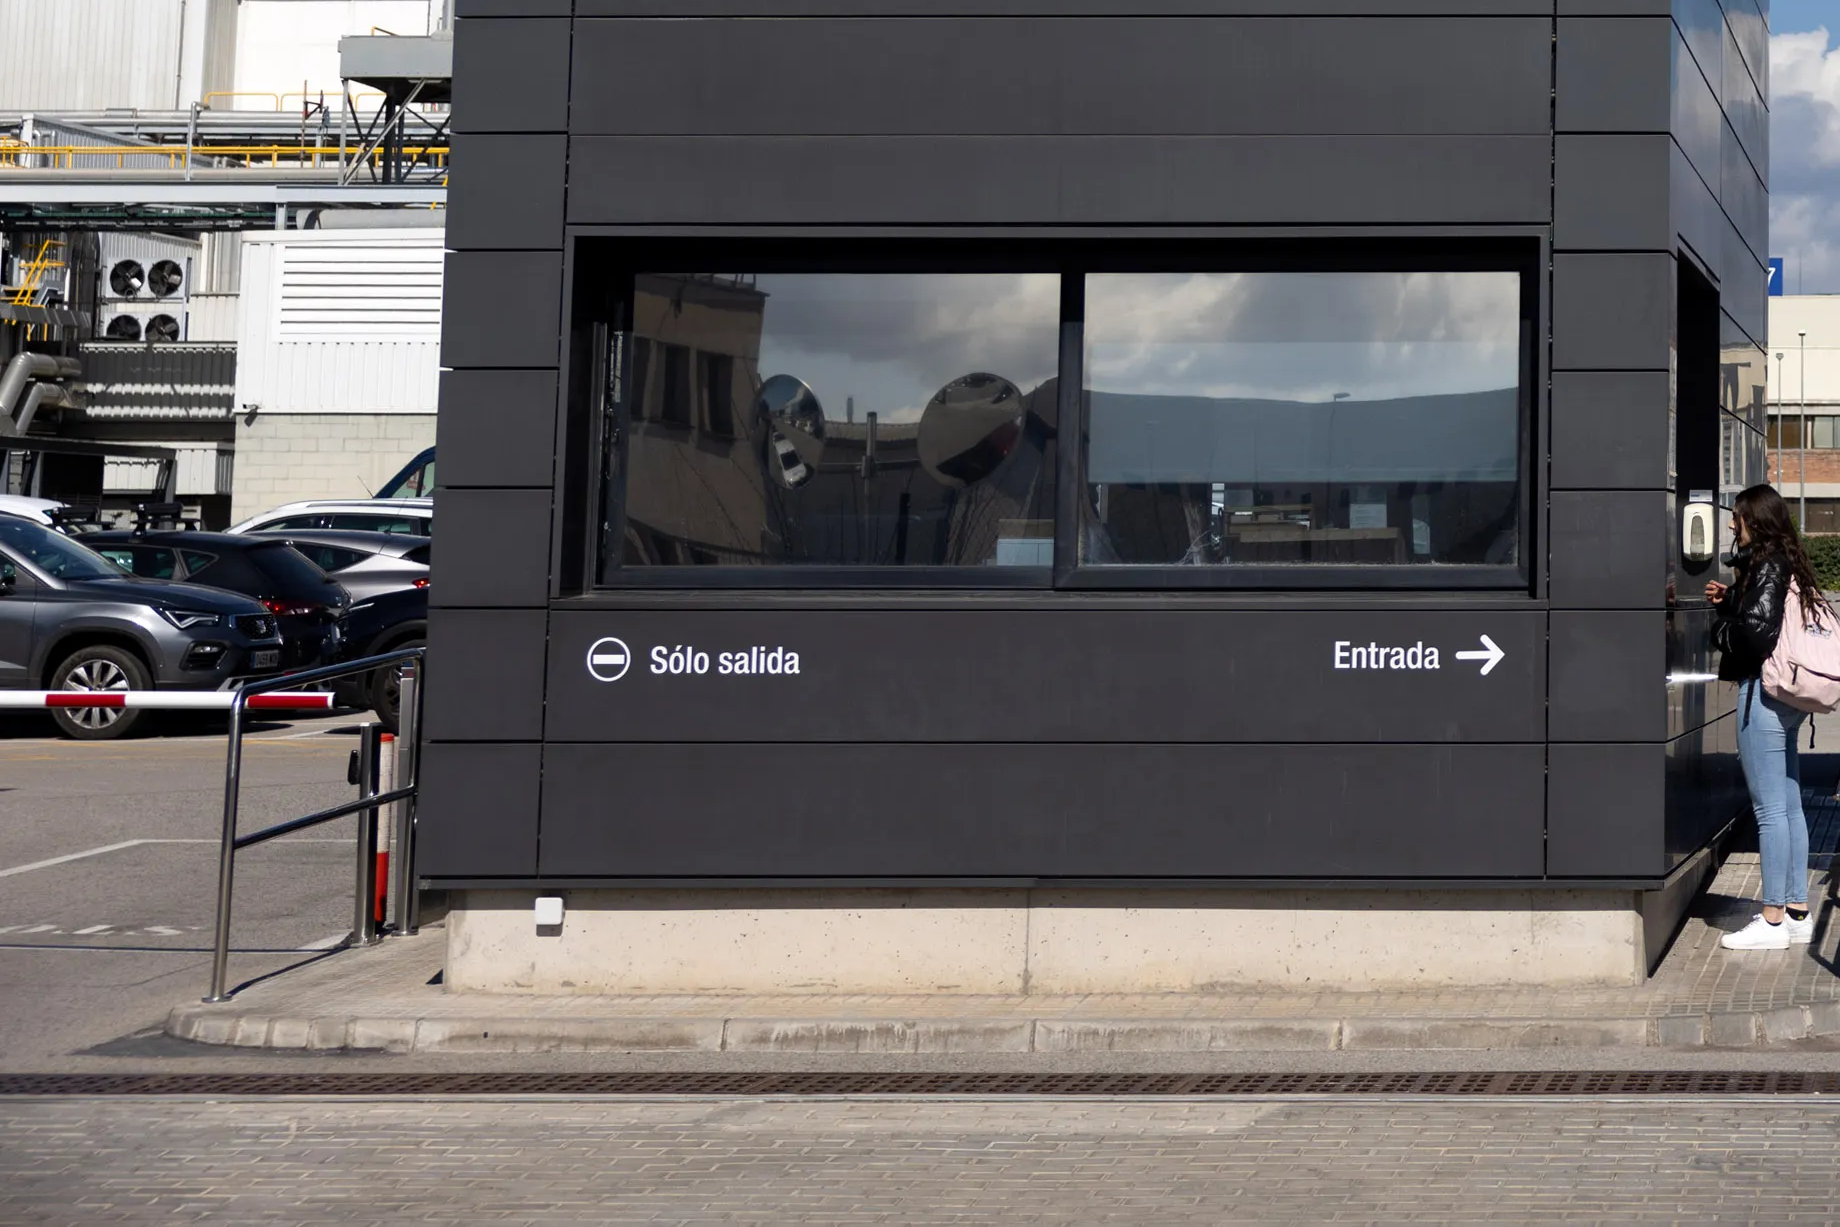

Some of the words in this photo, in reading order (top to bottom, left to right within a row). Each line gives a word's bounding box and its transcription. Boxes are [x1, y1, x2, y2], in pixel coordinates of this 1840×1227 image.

[650, 645, 710, 674] Sólo
[718, 646, 800, 674] salida
[1334, 641, 1441, 669] Entrada
